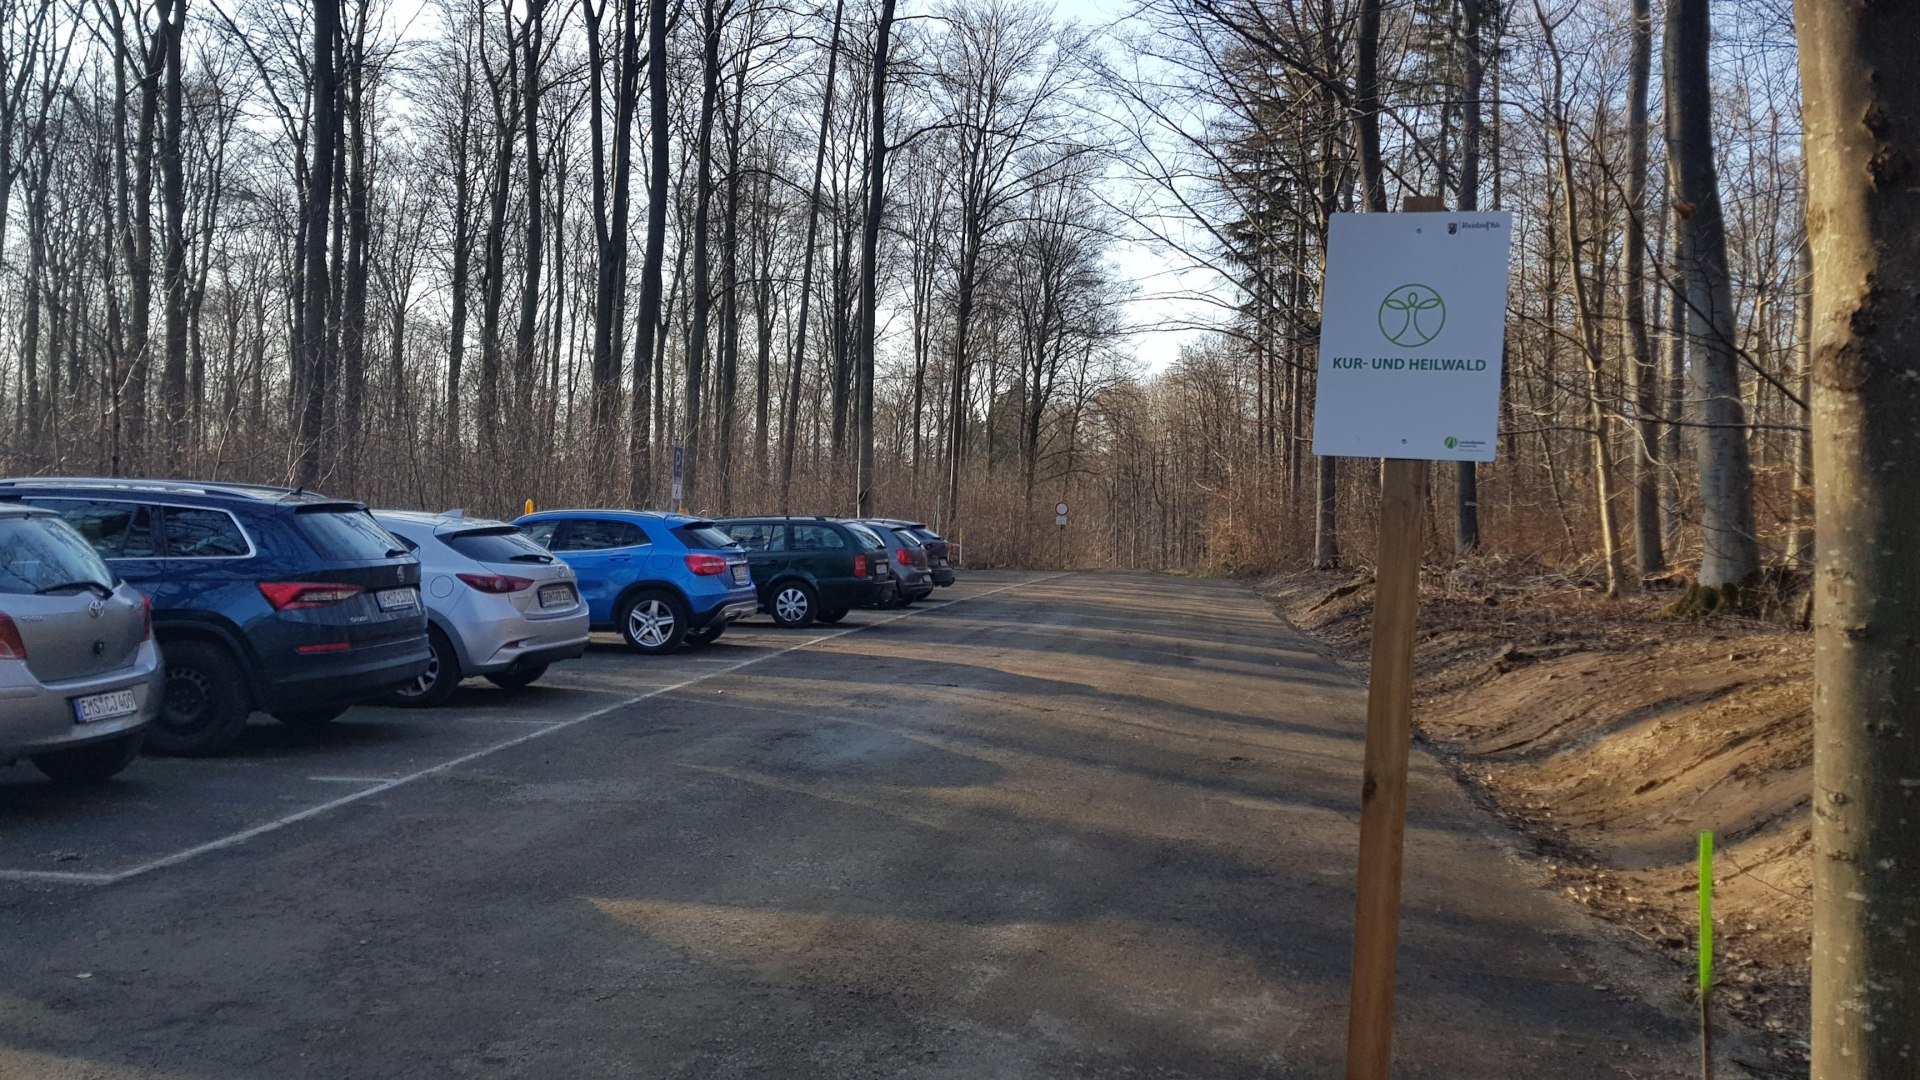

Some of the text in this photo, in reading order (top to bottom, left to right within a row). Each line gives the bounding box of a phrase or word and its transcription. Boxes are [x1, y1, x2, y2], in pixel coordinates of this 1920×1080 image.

[1332, 357, 1487, 371] KUR- UND HEILWALD
[675, 450, 682, 475] P
[80, 692, 135, 716] EMS CJ 409
